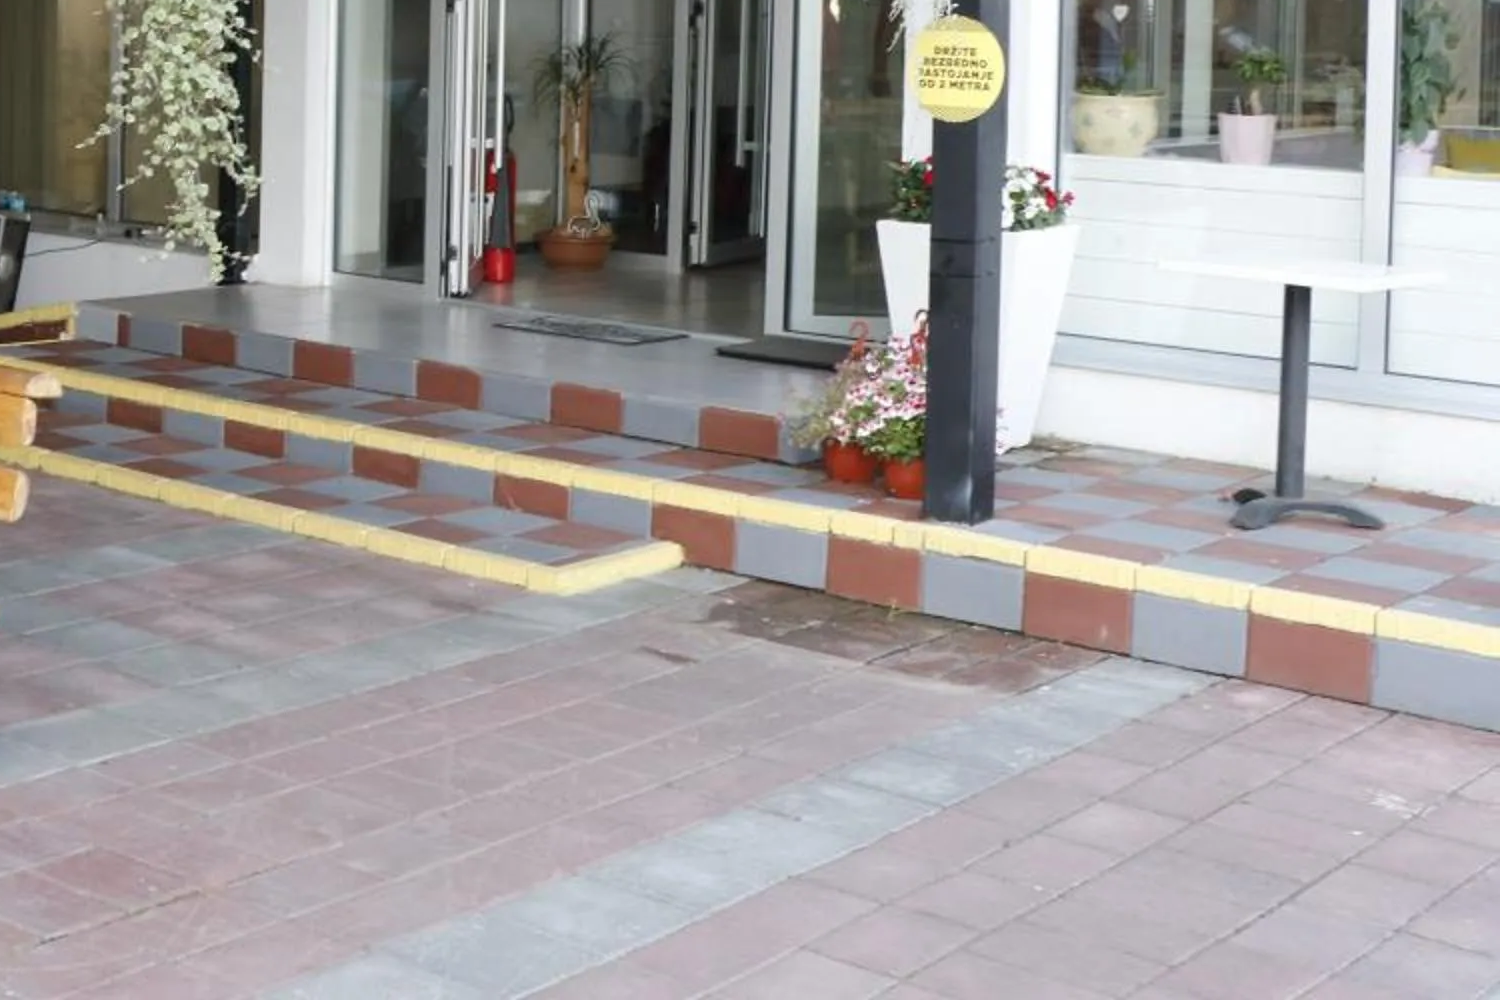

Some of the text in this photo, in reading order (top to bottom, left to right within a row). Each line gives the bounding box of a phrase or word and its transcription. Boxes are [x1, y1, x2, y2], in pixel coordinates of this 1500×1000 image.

[922, 57, 989, 69] BEZBEDNO
[918, 78, 991, 91] OD 2 METRA
